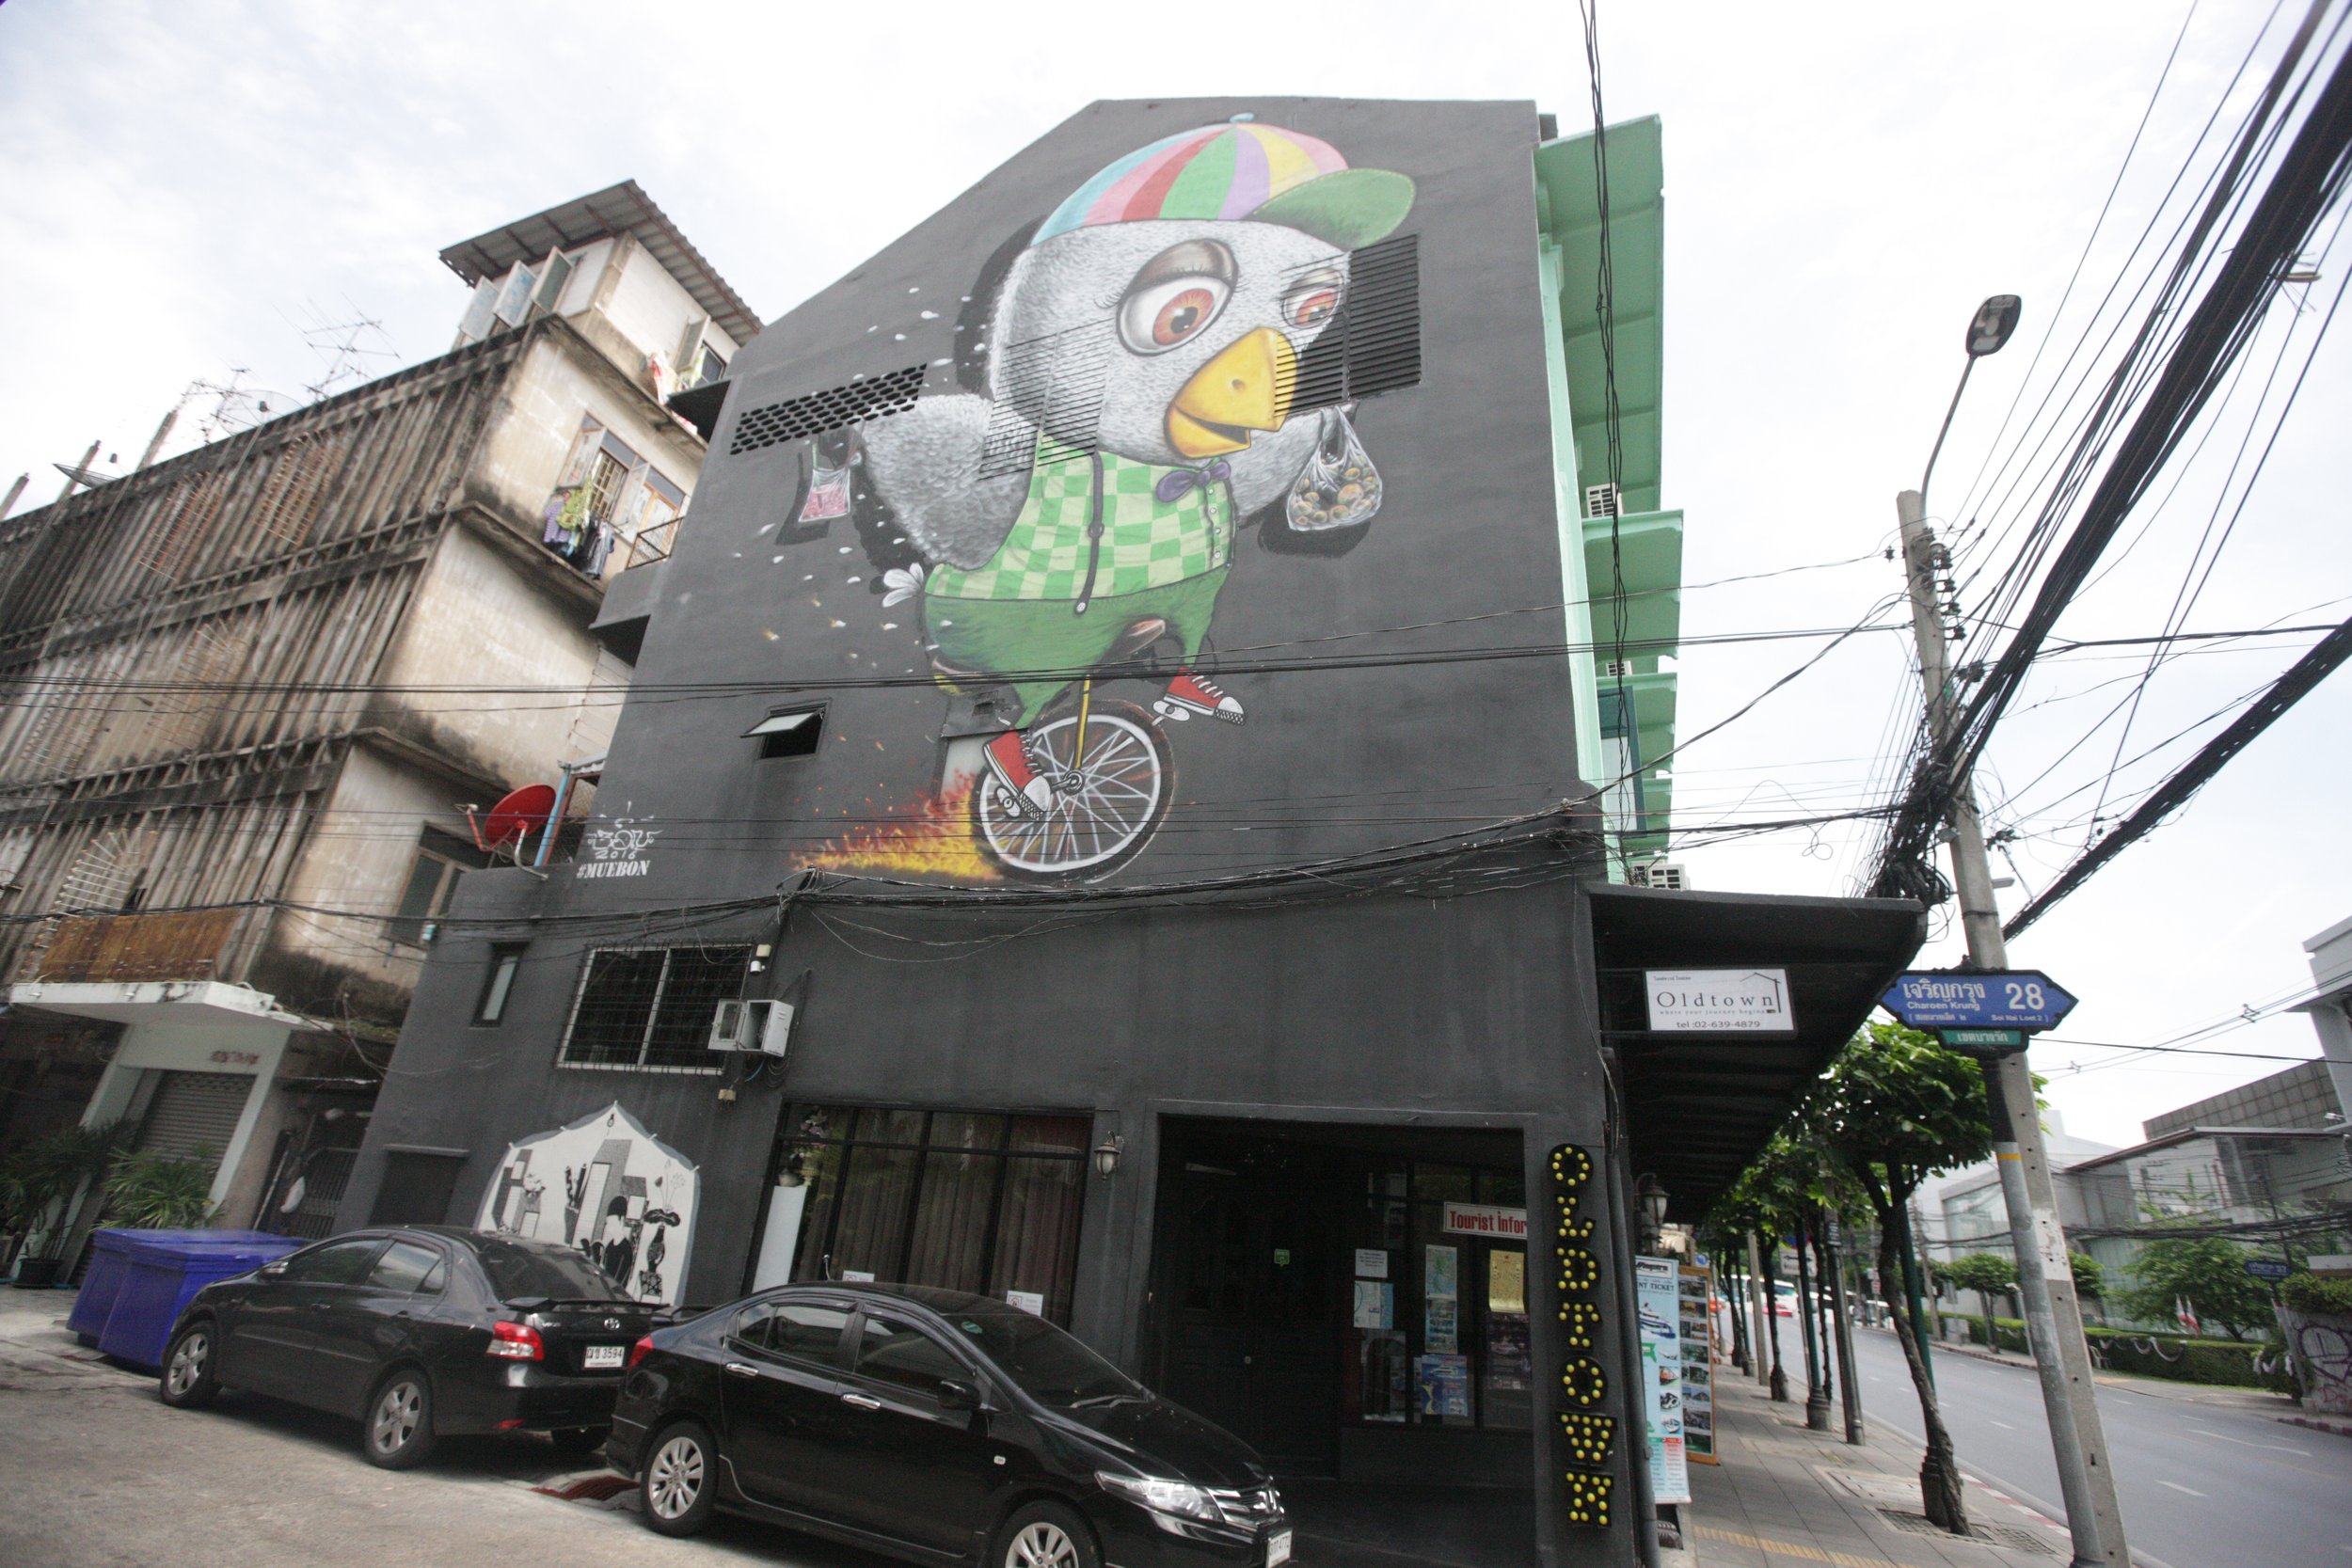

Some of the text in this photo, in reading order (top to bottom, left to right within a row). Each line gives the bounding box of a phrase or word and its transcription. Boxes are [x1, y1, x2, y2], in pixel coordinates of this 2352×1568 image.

[595, 850, 637, 860] 2016
[577, 860, 651, 879] #MUEBON
[1657, 991, 1773, 1007] Oldtown
[1903, 979, 2045, 1010] เจริญกรุง 28
[1951, 1002, 1980, 1011] Krung
[1450, 1211, 1528, 1234] Tourist infor
[1650, 1283, 1675, 1291] TICKET
[602, 1347, 623, 1358] 3594
